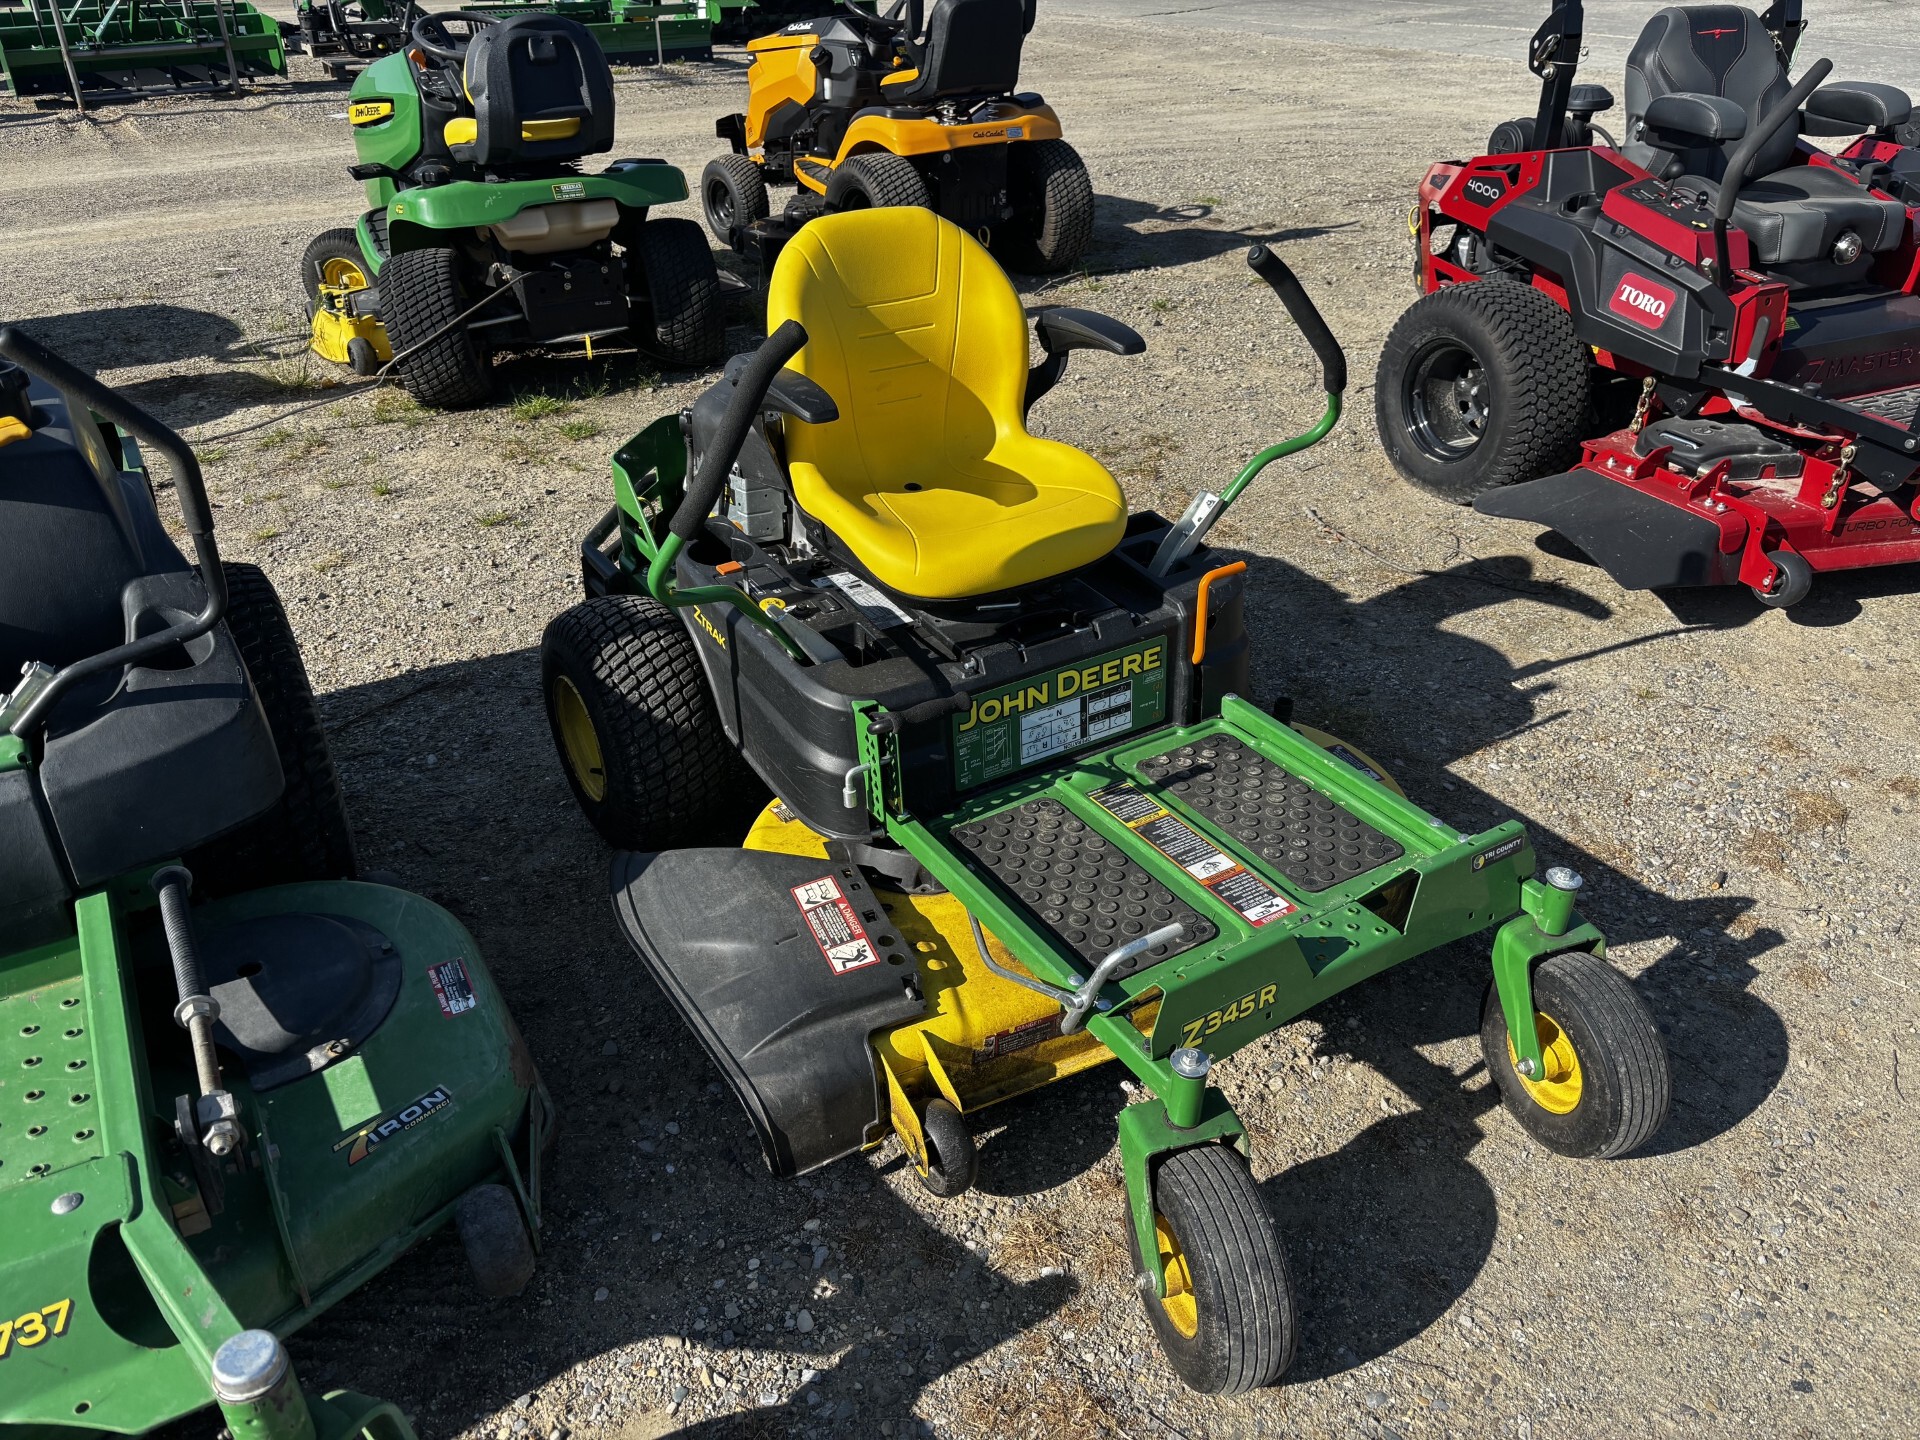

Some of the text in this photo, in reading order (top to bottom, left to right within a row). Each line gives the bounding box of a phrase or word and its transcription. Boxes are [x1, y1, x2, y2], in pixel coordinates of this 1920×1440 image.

[985, 130, 1004, 138] Cadet
[1467, 179, 1500, 200] 4000
[1618, 284, 1666, 317] TORO
[1826, 348, 1914, 379] MASTER
[1840, 520, 1887, 533] TURBO
[693, 604, 726, 650] ZTRAK
[959, 682, 1049, 732] JOHN
[1057, 646, 1162, 700] DEERE
[1063, 737, 1092, 751] OPERATION
[1484, 850, 1495, 860] TRI
[1496, 838, 1522, 855] COUNTY
[842, 908, 863, 935] DANGER
[404, 1098, 450, 1131] COMMERCI
[0, 1298, 73, 1358] 737
